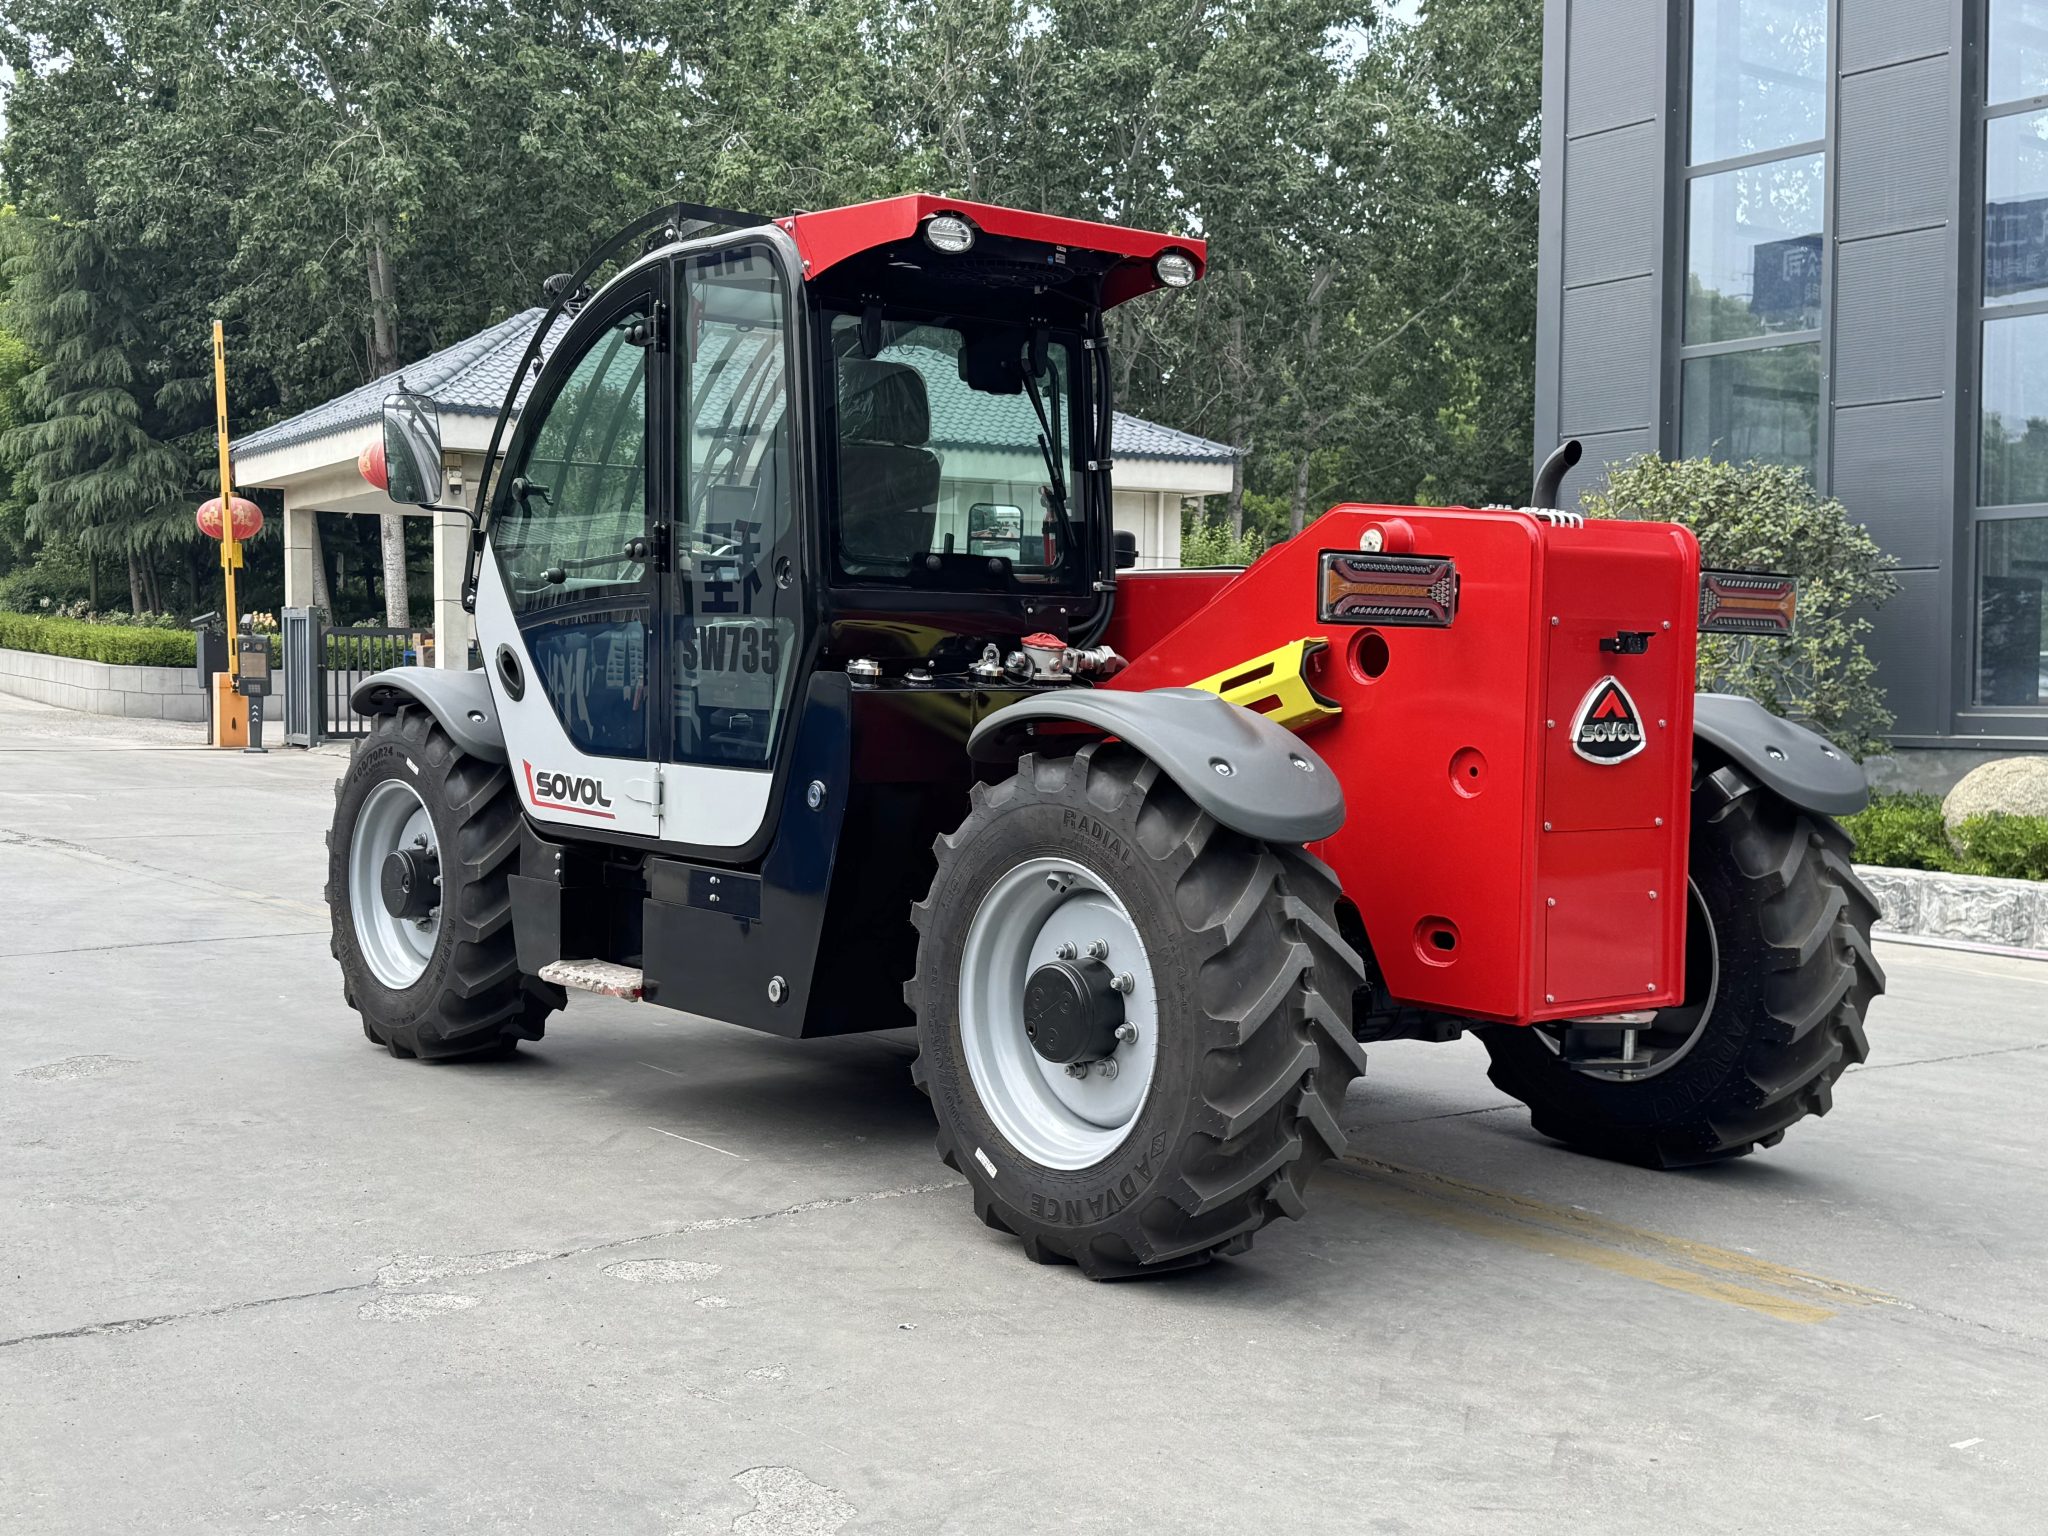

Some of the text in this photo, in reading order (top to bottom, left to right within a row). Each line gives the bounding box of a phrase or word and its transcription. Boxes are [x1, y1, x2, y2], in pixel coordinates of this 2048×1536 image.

[243, 642, 249, 651] P
[683, 625, 780, 675] SW735
[1582, 721, 1641, 742] SOVOL
[537, 771, 612, 808] SOVOL
[1063, 808, 1132, 871] RADIAL
[1029, 1151, 1154, 1227] ADVANCE
